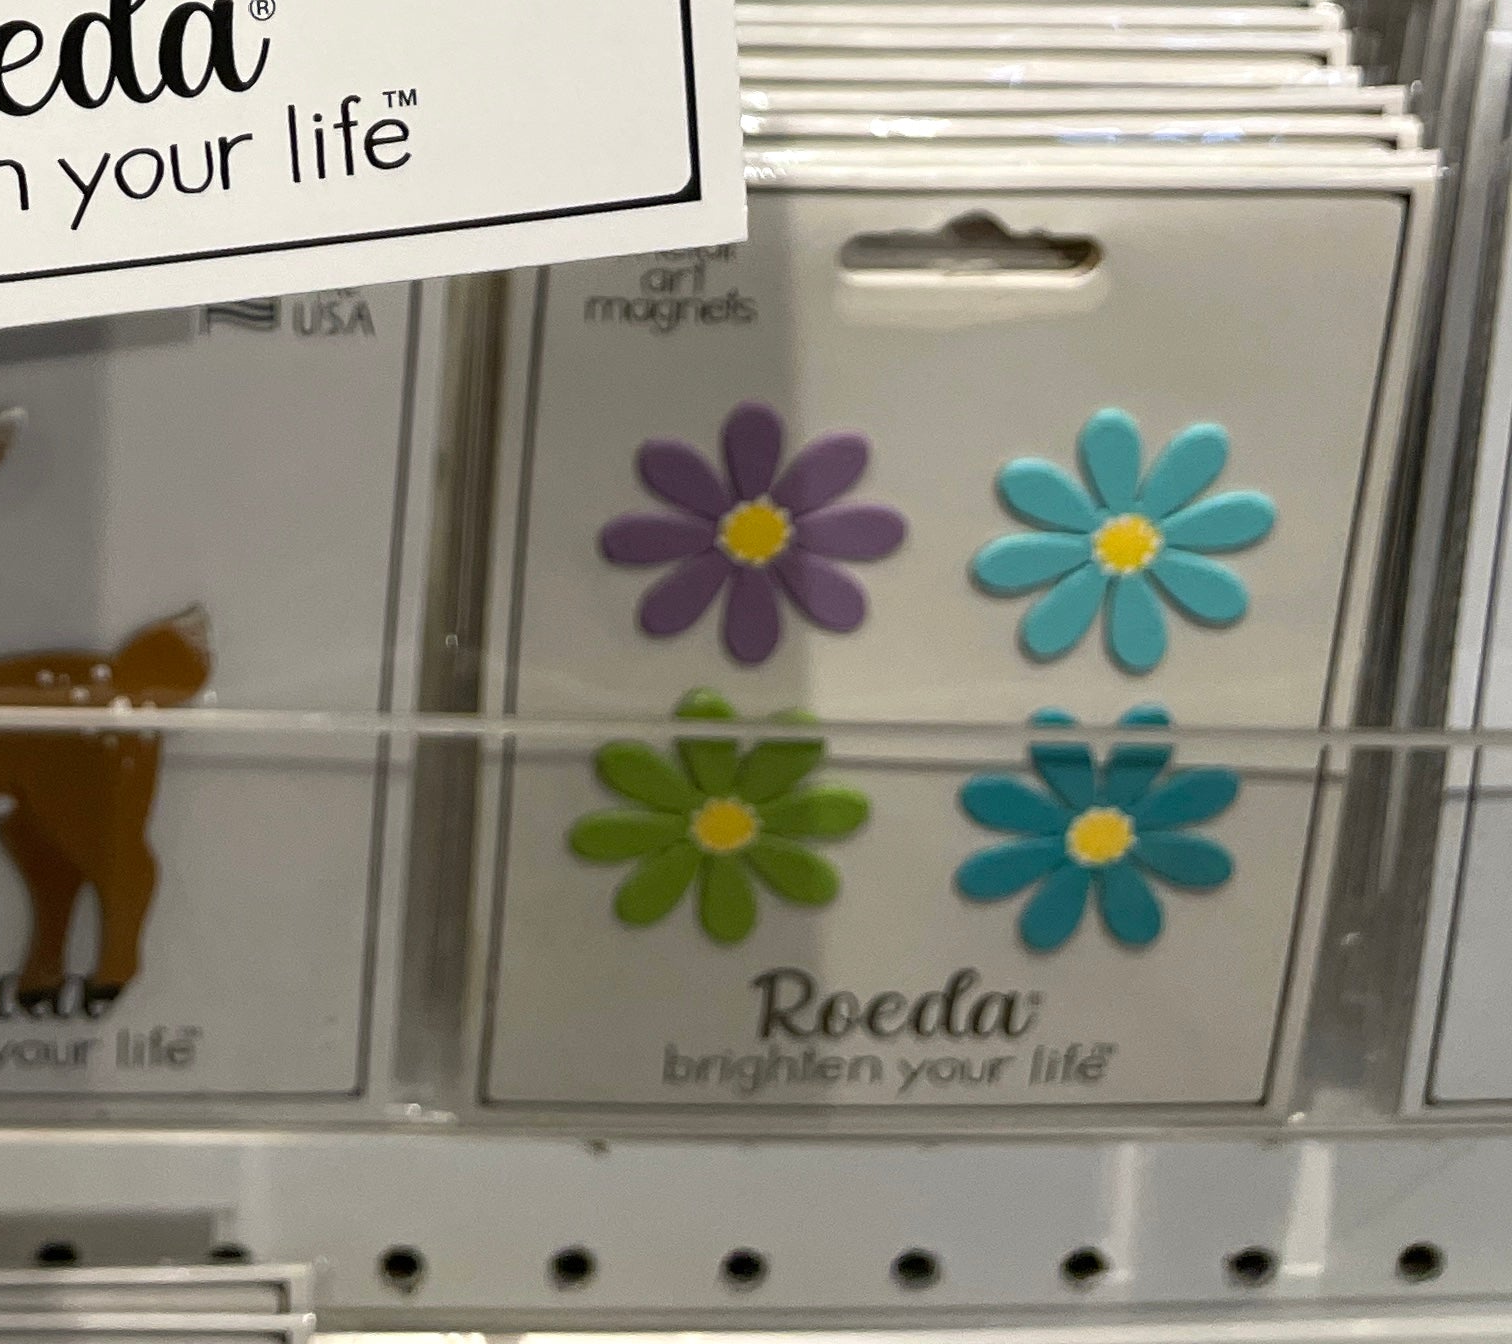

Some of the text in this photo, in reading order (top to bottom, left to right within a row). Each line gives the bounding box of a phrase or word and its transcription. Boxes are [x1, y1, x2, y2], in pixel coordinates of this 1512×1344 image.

[58, 133, 253, 232] your
[290, 298, 377, 337] USA
[661, 1042, 884, 1097] brighten
[895, 1052, 1016, 1096] your
